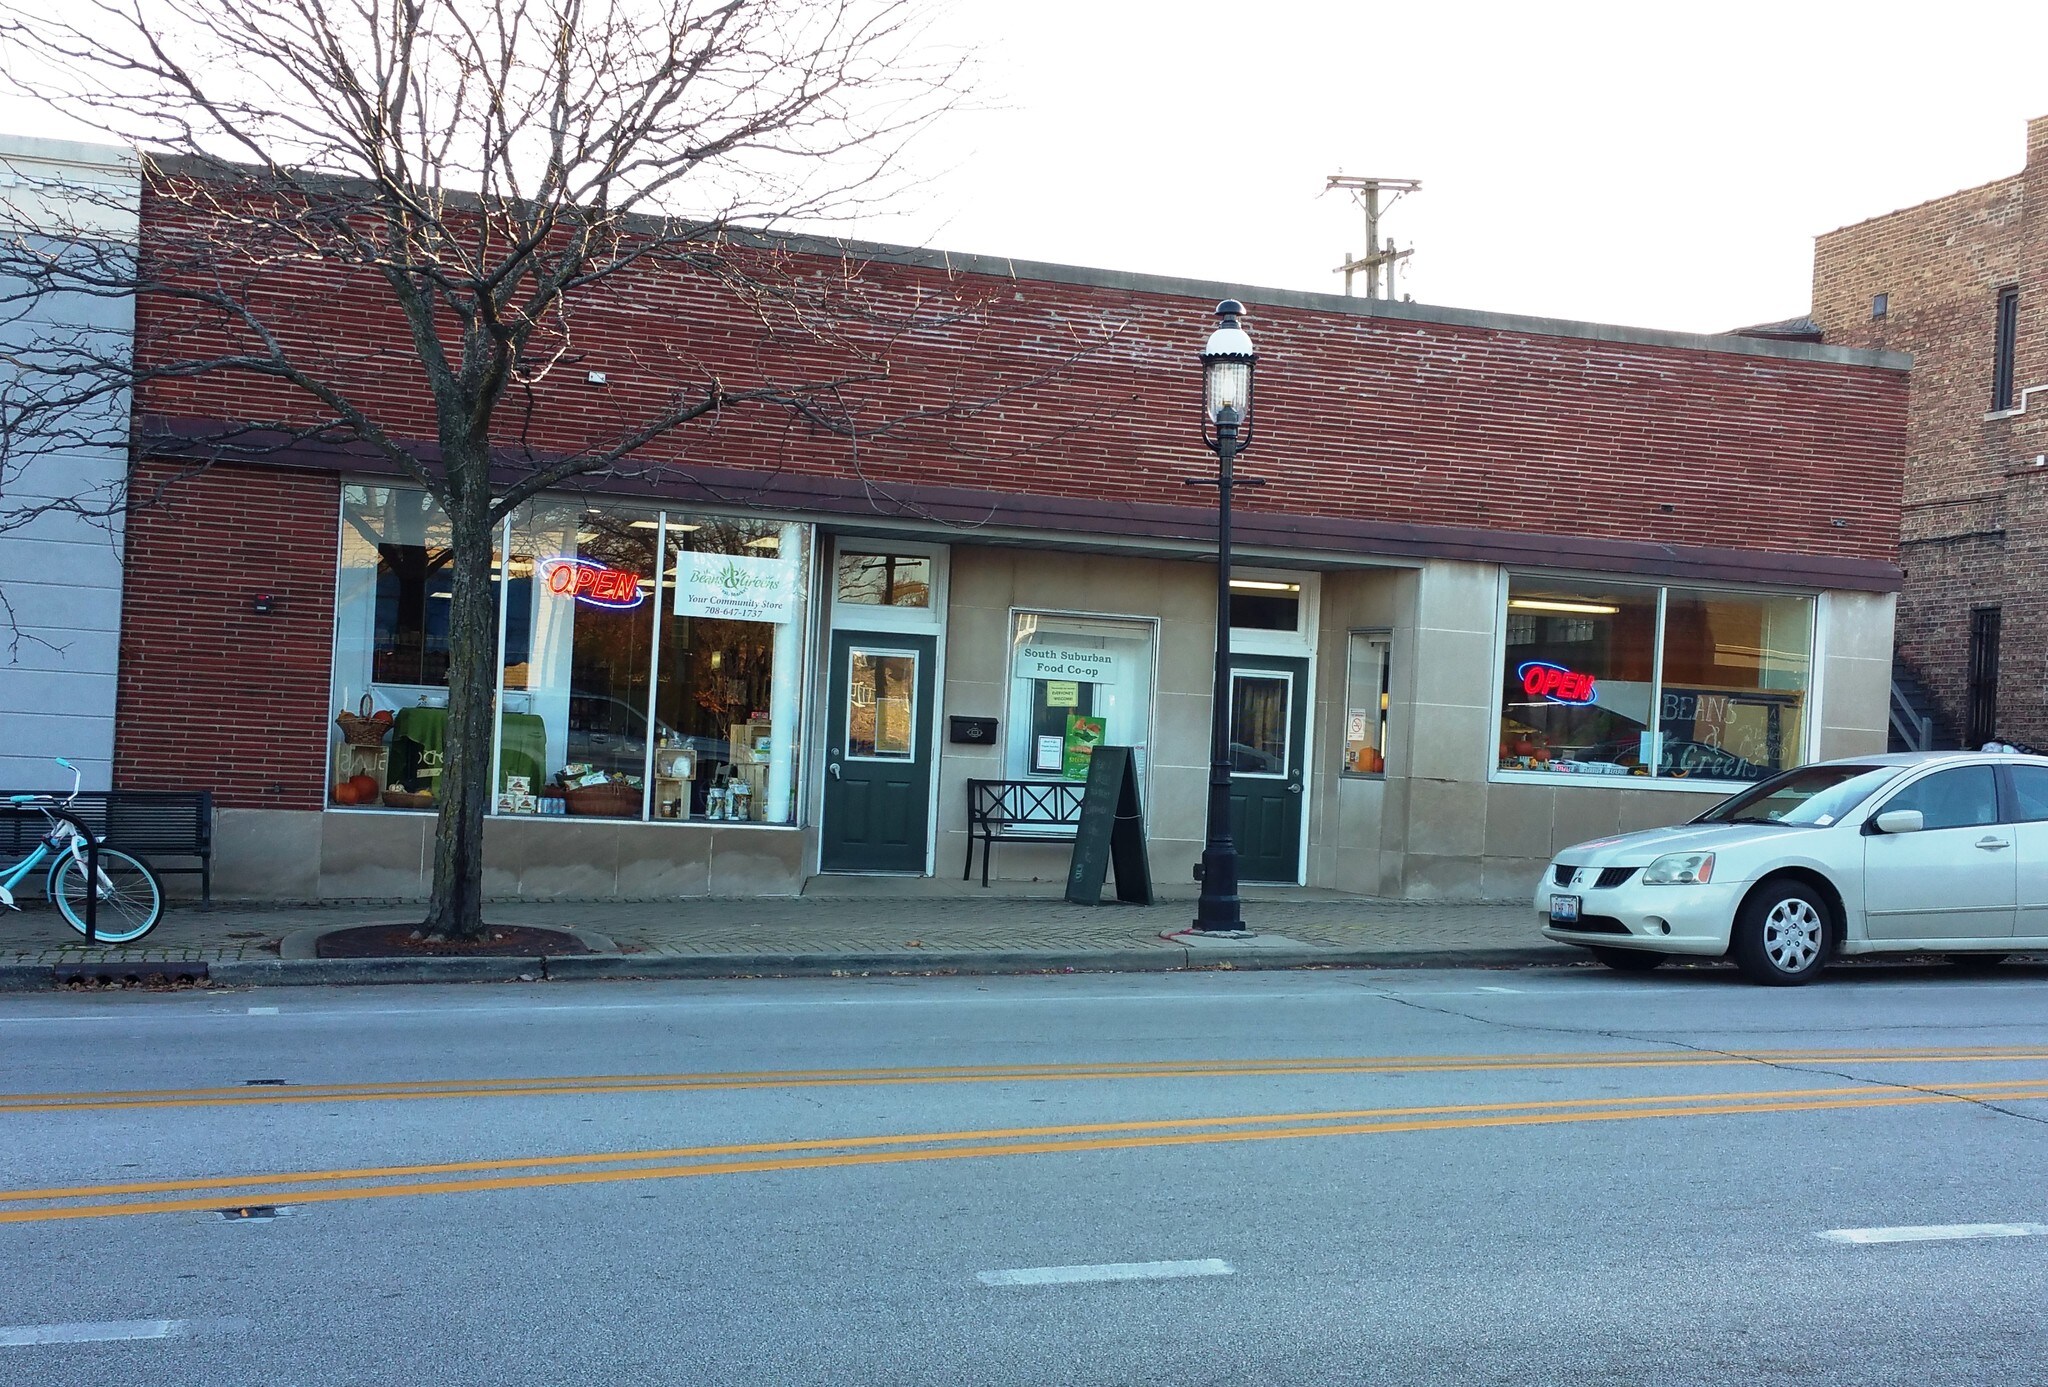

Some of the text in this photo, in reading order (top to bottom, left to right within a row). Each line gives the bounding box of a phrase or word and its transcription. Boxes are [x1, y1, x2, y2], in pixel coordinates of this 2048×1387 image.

[549, 564, 638, 601] OPEN
[690, 558, 780, 590] Beans & Greens
[688, 594, 783, 610] Your Community Store
[705, 606, 763, 618] 708-647-1737
[1024, 648, 1112, 664] South Suburban
[1037, 663, 1099, 677] Food Co-op
[1523, 666, 1595, 701] OPEN
[1660, 693, 1738, 725] BEANS
[1680, 745, 1762, 778] Greens
